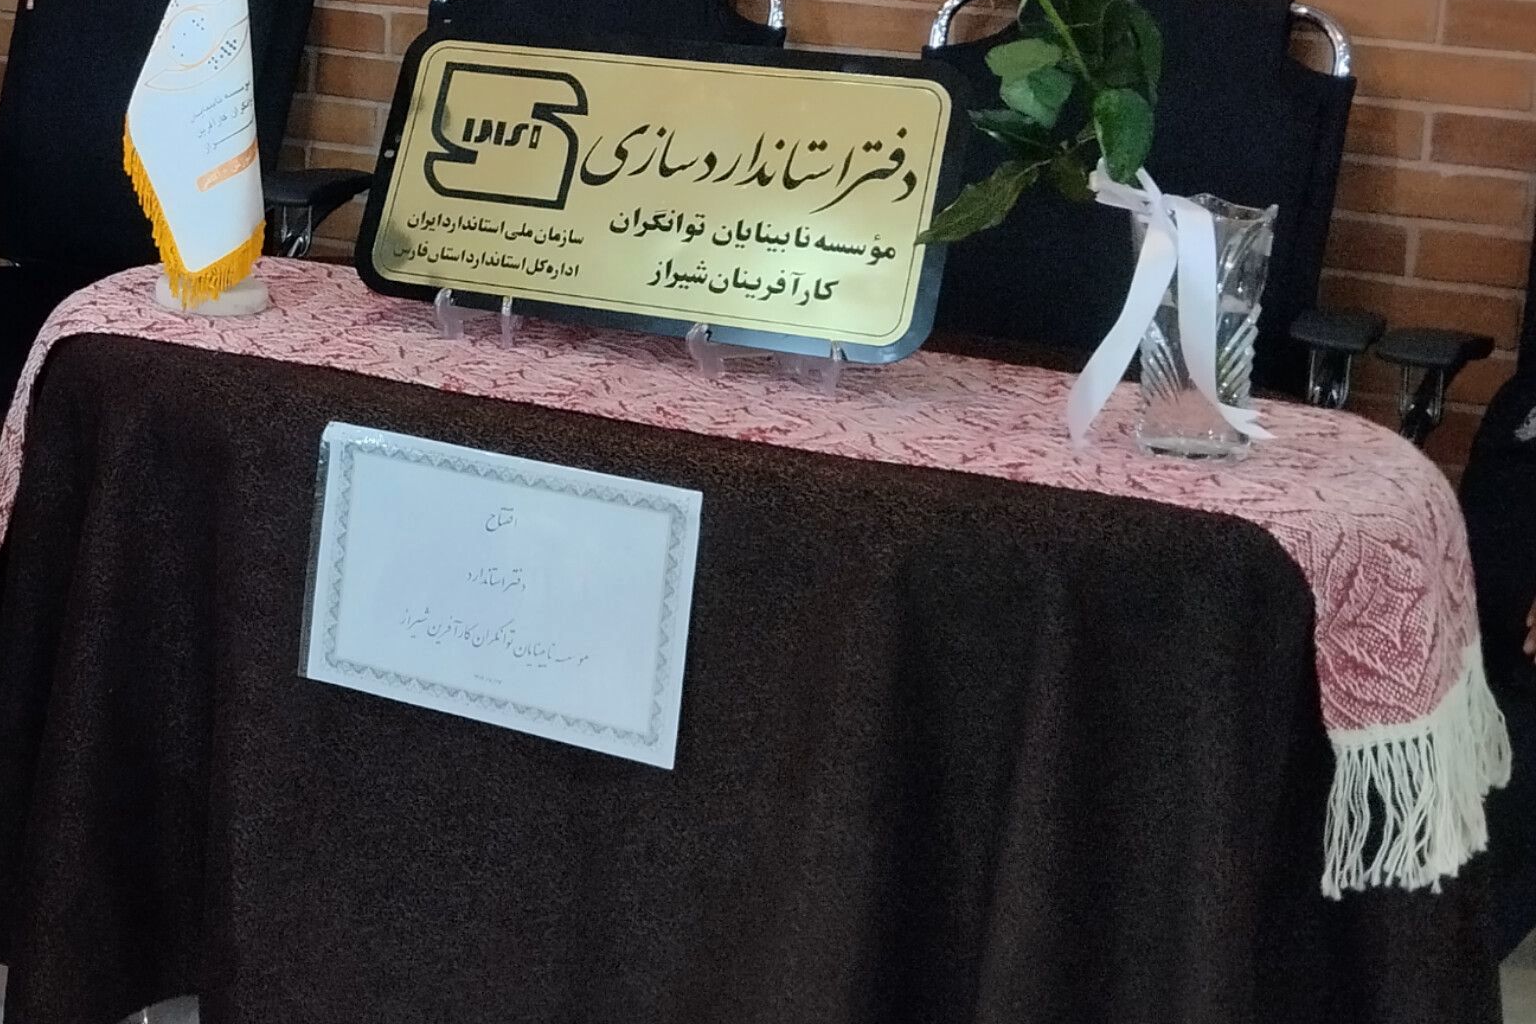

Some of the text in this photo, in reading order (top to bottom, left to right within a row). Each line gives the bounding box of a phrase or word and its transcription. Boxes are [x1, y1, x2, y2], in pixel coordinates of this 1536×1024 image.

[809, 127, 917, 215] دفتر
[407, 211, 585, 247] سازمان ملی استاندارد ایران
[609, 207, 706, 243] توانگران
[393, 240, 580, 280] اداره کل استاندارد استان فارس
[647, 258, 709, 291] شیراز
[466, 567, 527, 593] دفتر استاندارد
[471, 618, 516, 649] توانگران
